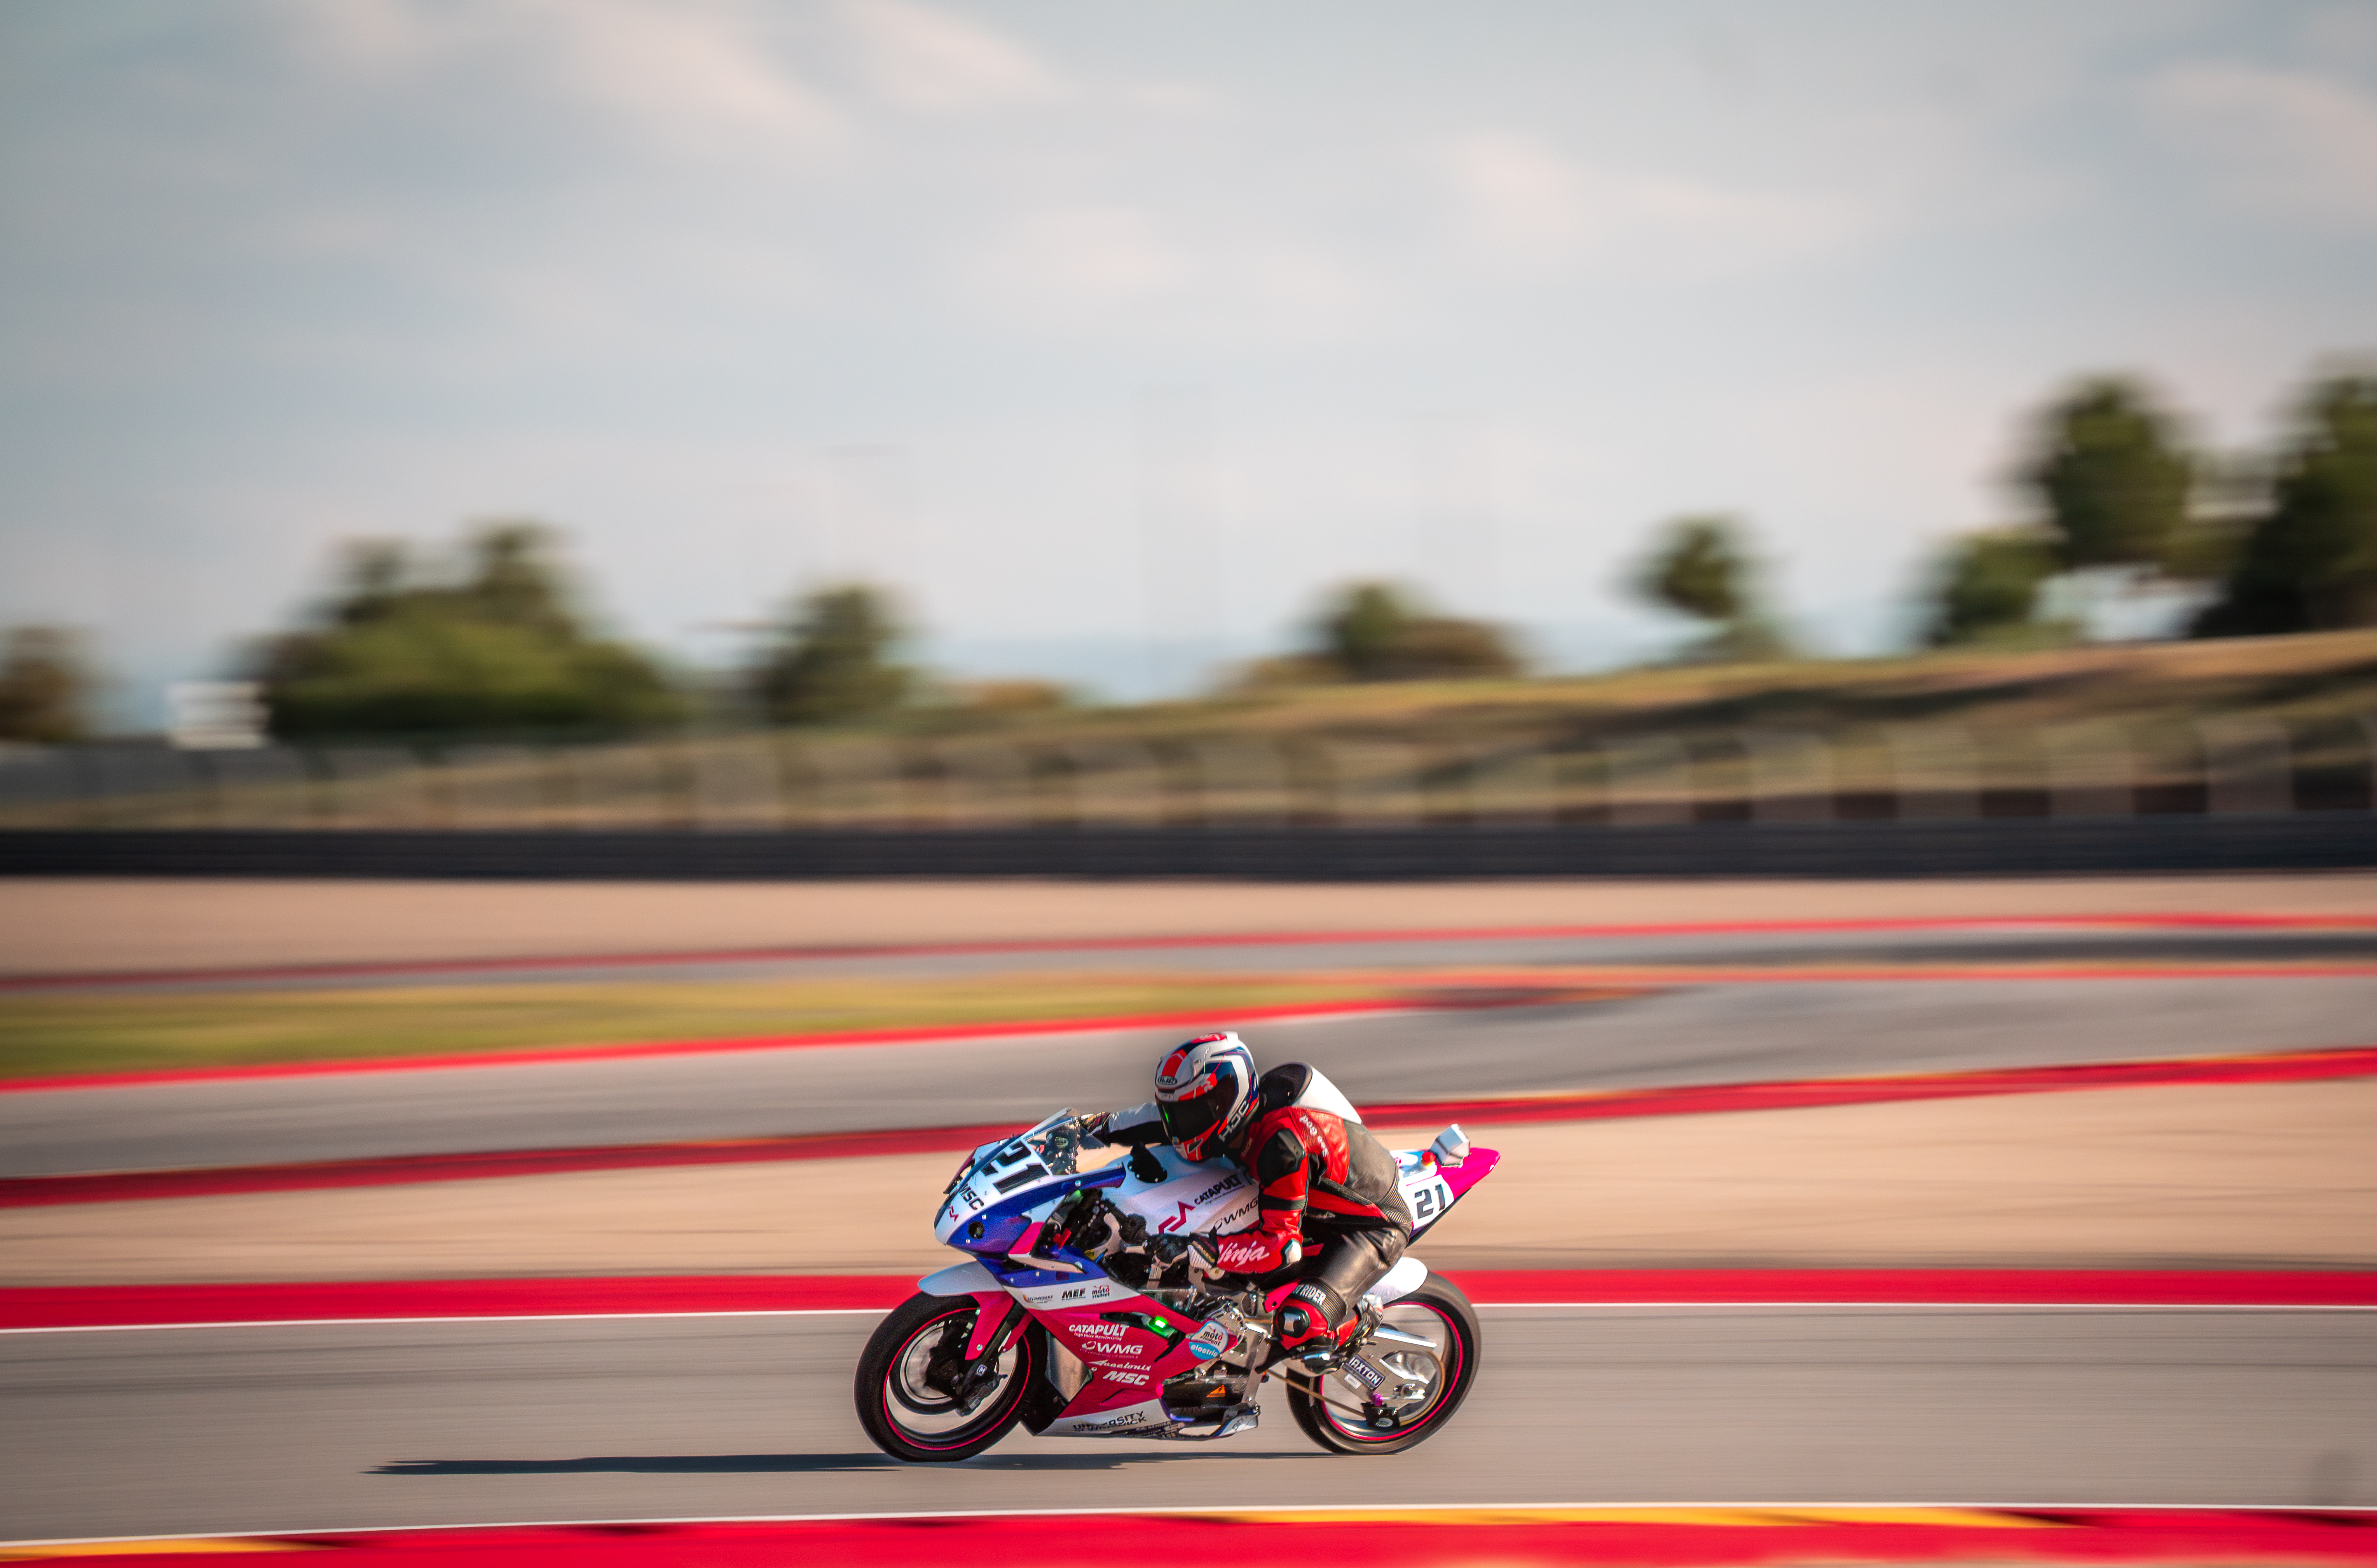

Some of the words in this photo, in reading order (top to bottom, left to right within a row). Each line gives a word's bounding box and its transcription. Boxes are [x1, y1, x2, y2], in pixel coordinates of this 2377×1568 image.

[1218, 1100, 1249, 1142] HJC
[980, 1140, 1049, 1195] 21
[1194, 1174, 1242, 1204] CATAPULT
[1414, 1184, 1445, 1219] 21
[1069, 1324, 1129, 1337] CATAPULT
[1097, 1342, 1143, 1354] WMG
[1103, 1371, 1149, 1386] MSC
[1349, 1357, 1381, 1385] AXTON
